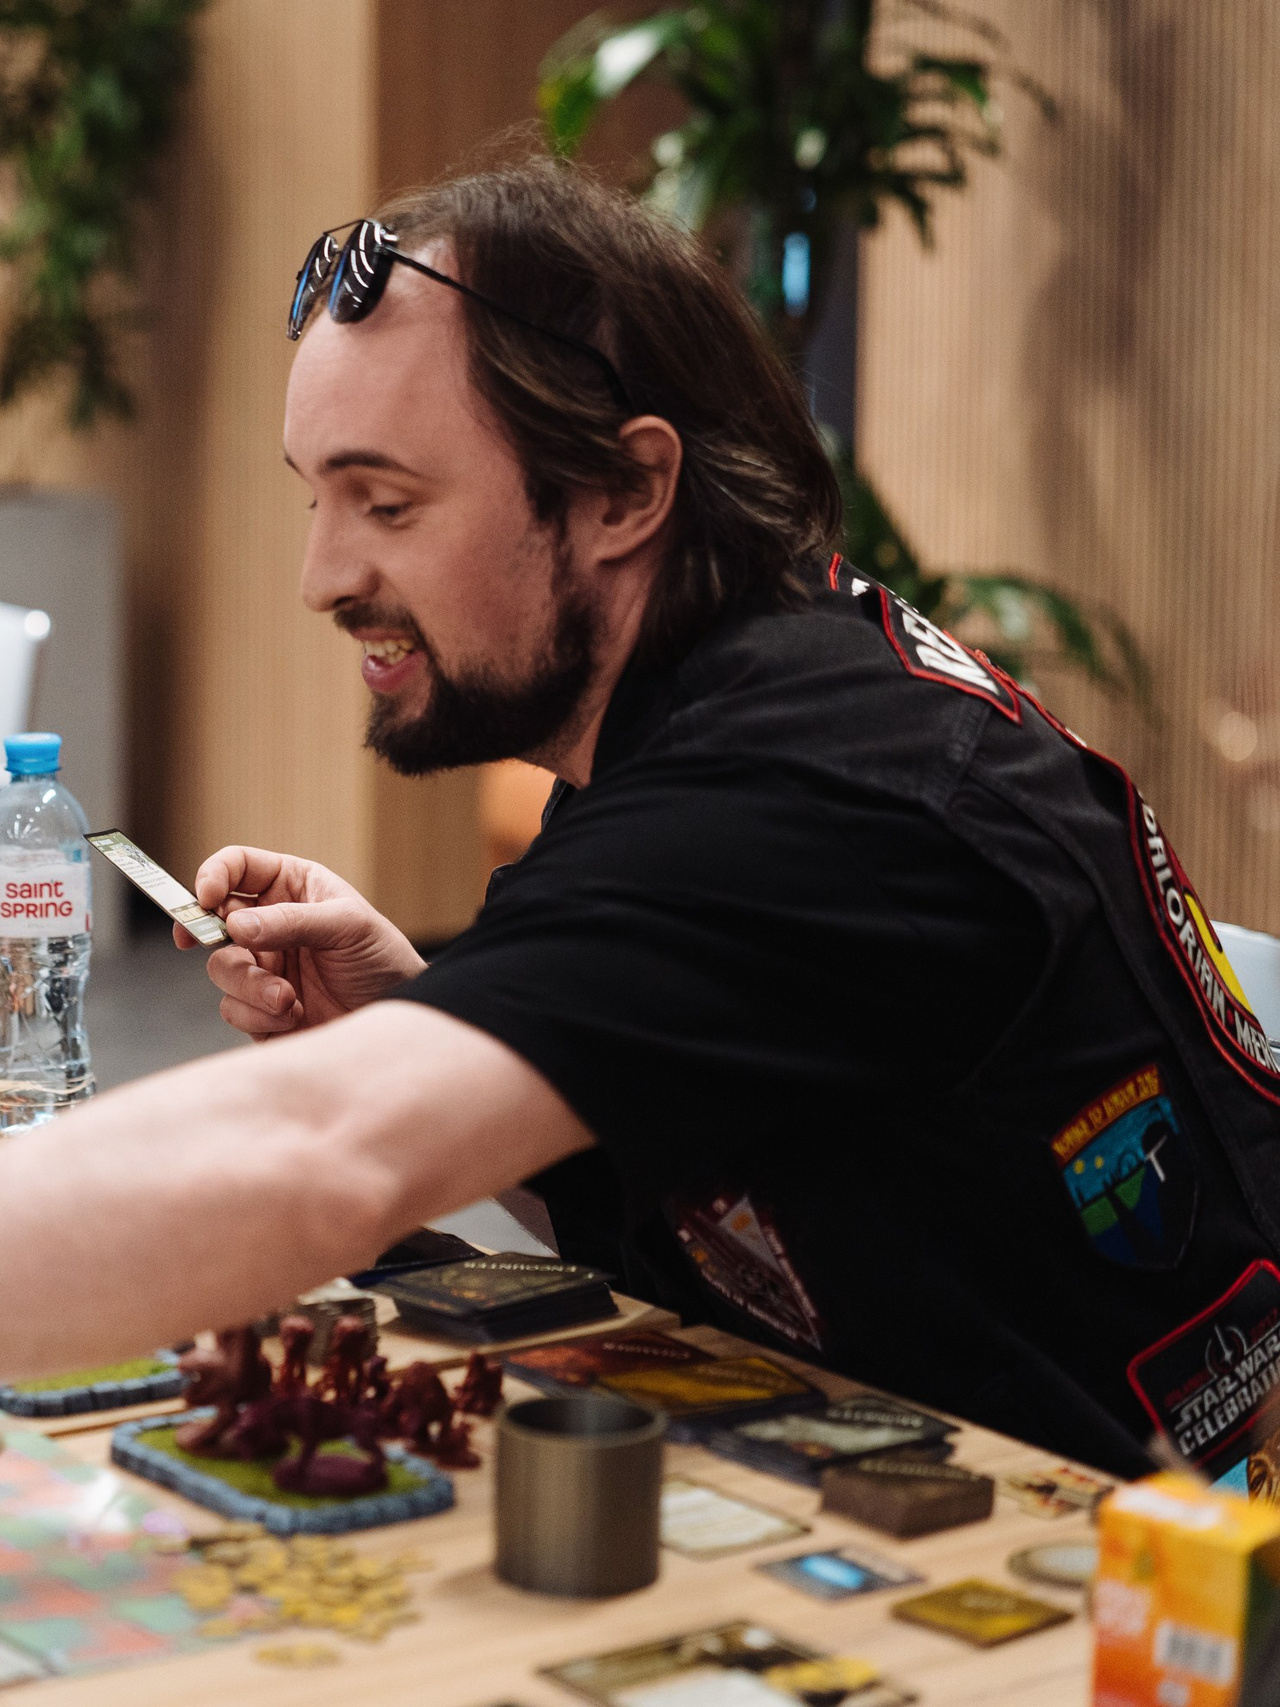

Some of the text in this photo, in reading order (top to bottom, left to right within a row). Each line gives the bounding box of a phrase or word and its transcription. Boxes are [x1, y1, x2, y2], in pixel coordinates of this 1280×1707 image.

[0, 901, 73, 918] SPRING
[1174, 1375, 1239, 1432] STAR
[1234, 1329, 1280, 1384] WAR
